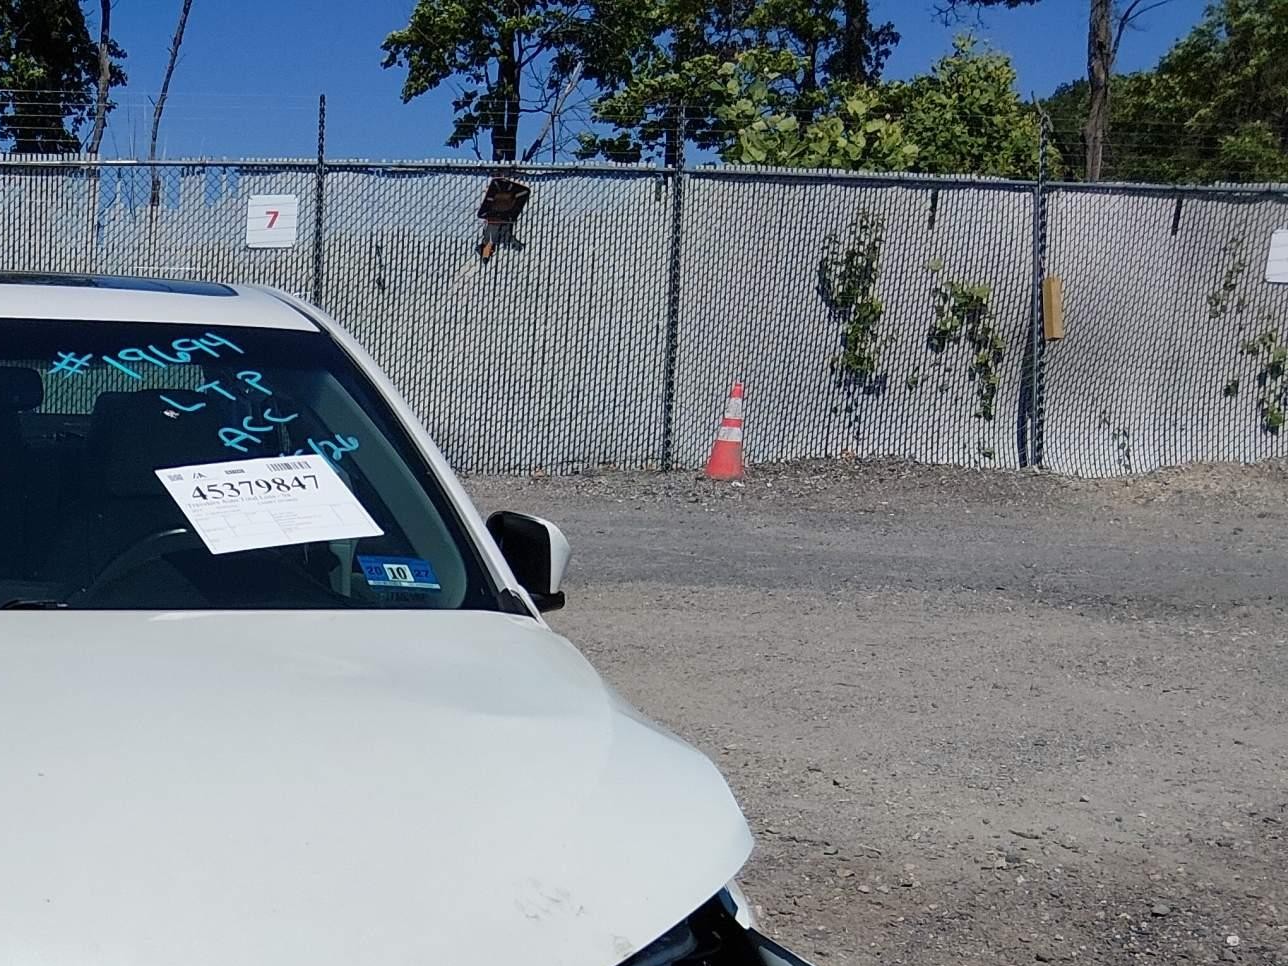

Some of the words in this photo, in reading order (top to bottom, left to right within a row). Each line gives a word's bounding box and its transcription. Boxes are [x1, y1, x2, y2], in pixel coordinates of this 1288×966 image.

[265, 210, 279, 229] 7
[191, 474, 319, 500] 45379847
[388, 566, 408, 580] 10
